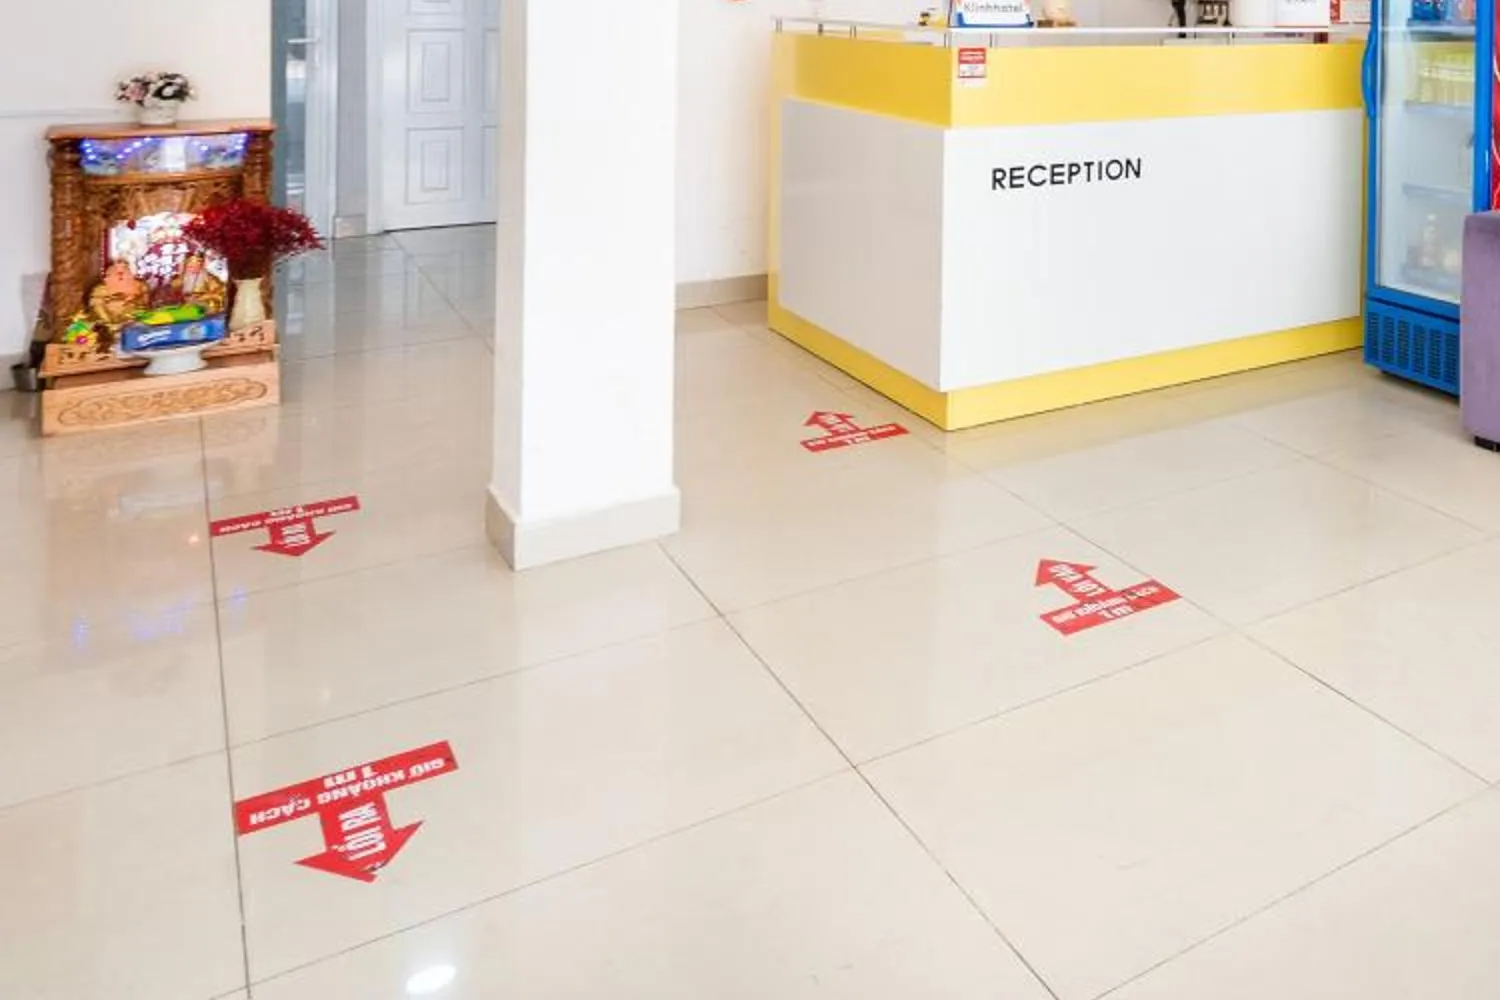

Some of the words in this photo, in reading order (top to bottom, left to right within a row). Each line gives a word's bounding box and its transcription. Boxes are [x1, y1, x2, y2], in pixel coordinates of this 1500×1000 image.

[991, 157, 1142, 191] RECEPTION
[316, 770, 405, 804] KHOẢNG
[249, 794, 311, 825] CÁCH
